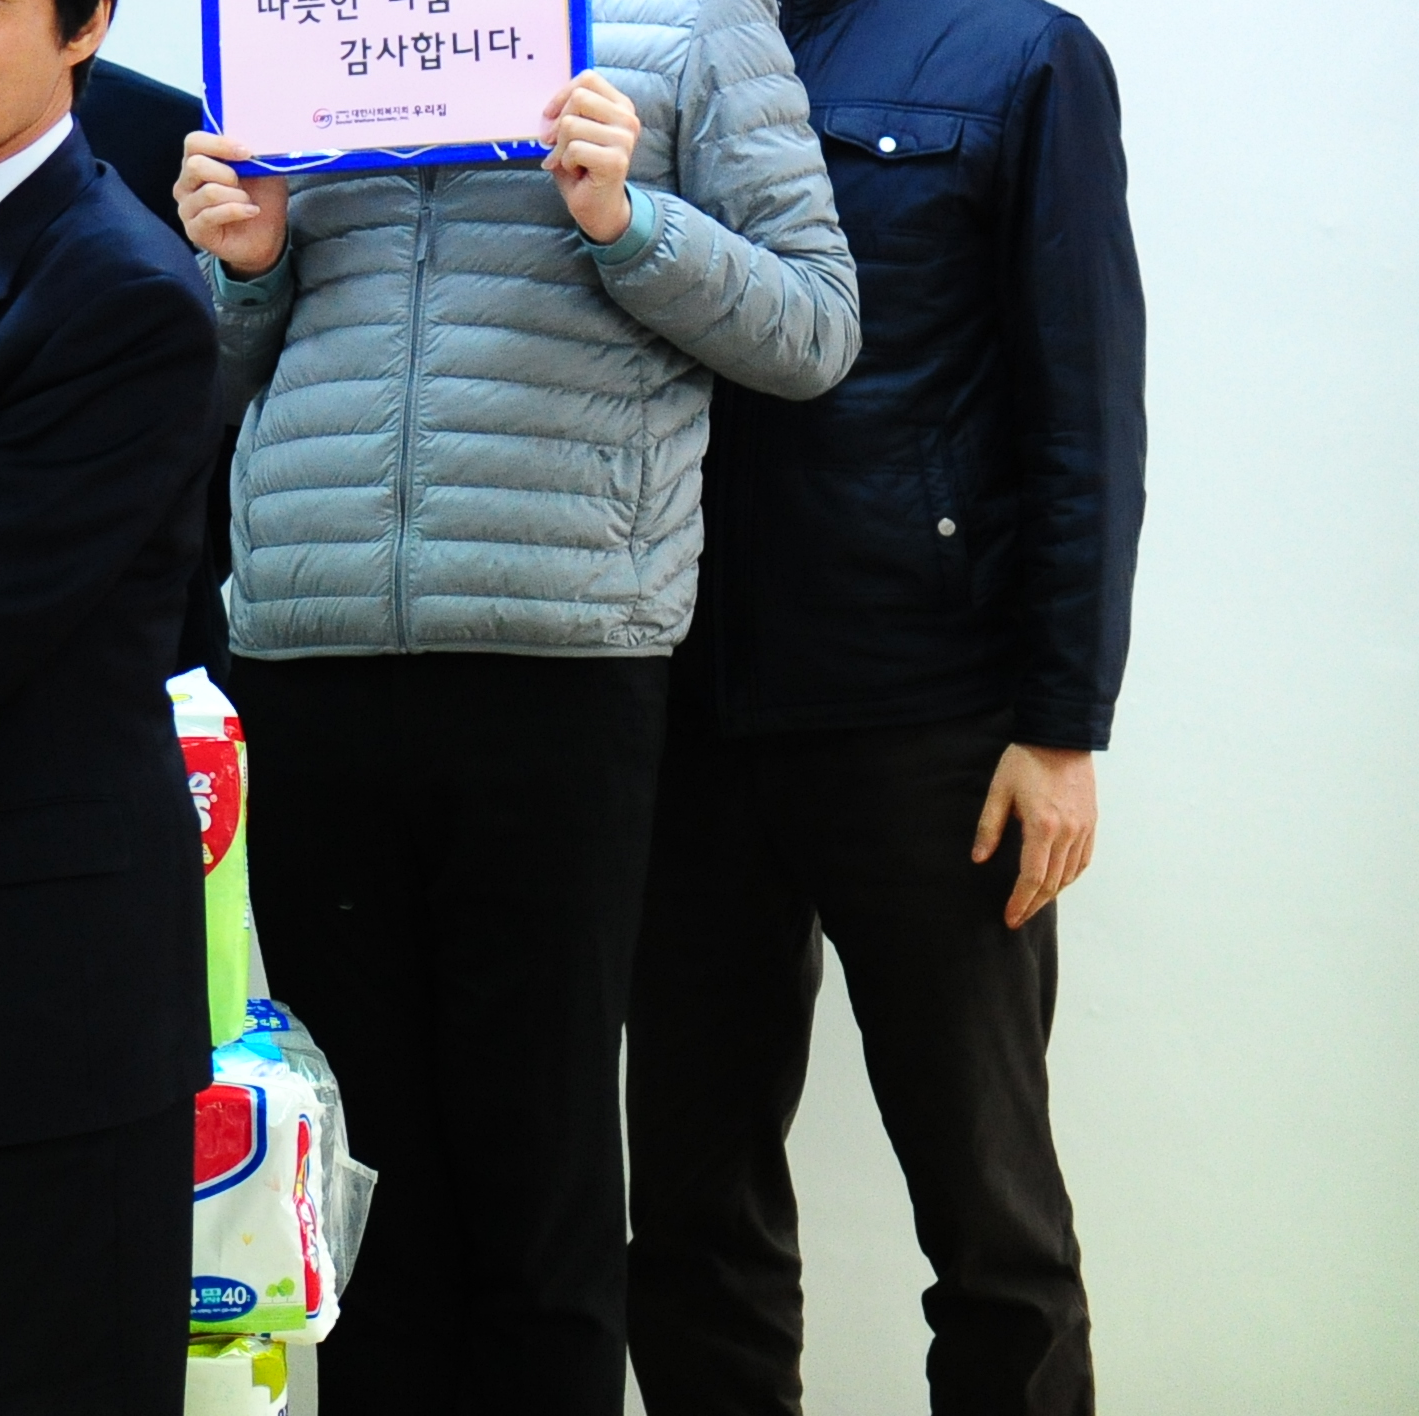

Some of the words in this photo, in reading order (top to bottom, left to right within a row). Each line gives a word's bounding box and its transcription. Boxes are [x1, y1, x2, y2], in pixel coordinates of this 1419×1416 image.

[340, 27, 534, 76] 감사합니다.
[412, 103, 447, 117] 우리집
[221, 1286, 247, 1305] 40
